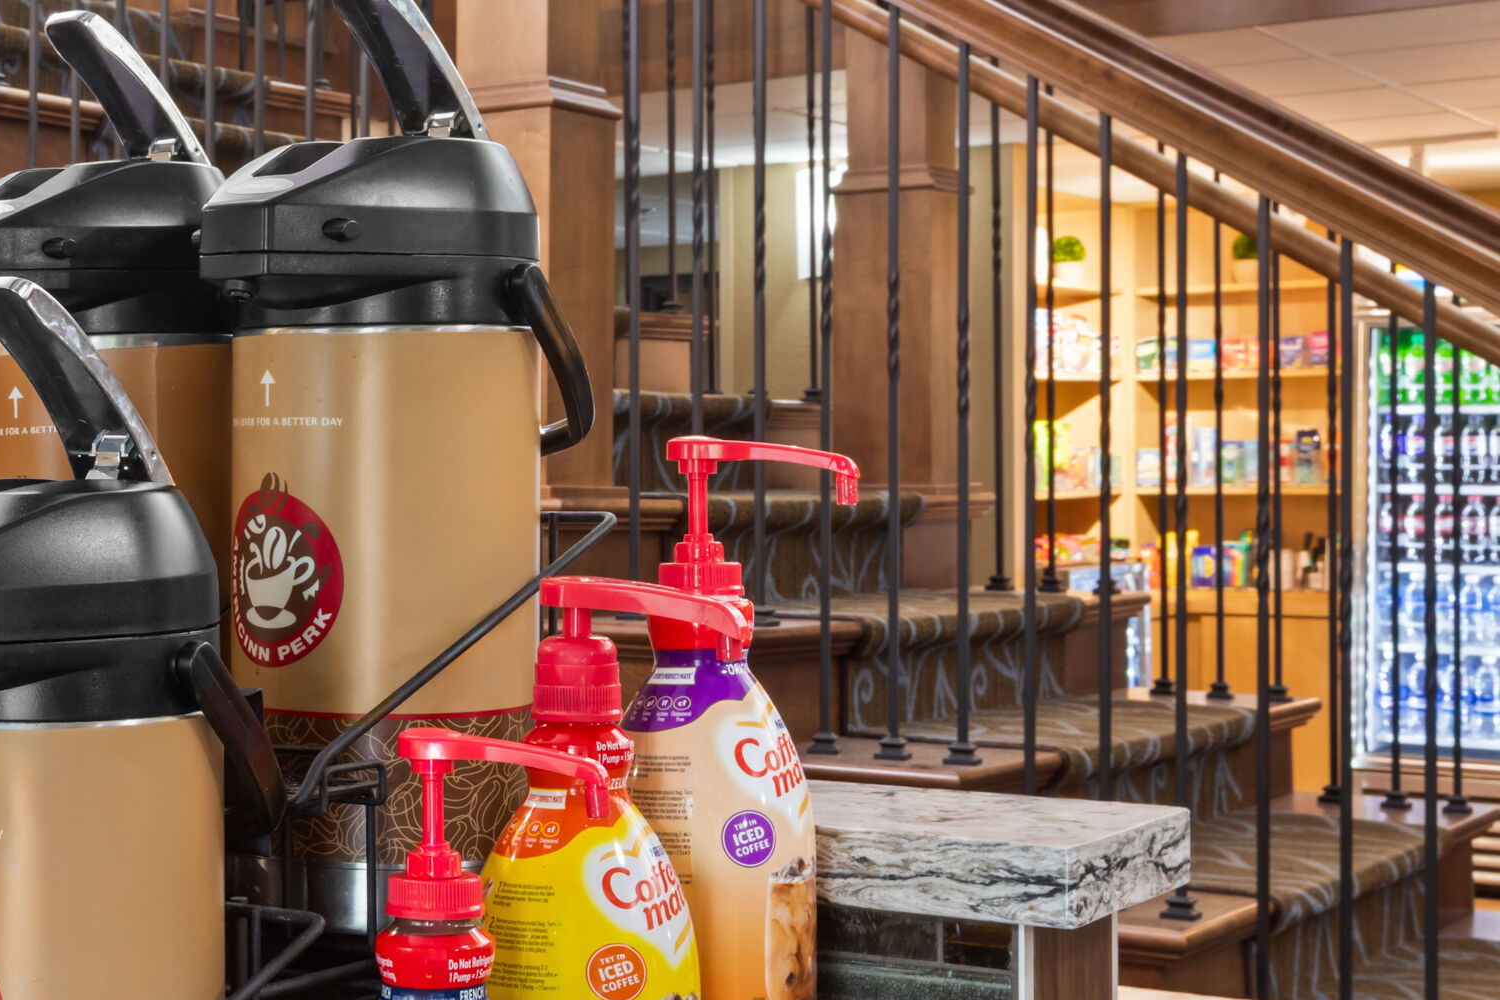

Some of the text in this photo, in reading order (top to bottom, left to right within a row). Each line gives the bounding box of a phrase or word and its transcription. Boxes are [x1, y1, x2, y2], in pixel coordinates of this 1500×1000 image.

[273, 417, 279, 426] A
[281, 417, 317, 426] BETTER
[321, 417, 343, 426] DAY
[277, 608, 332, 661] PERK
[596, 741, 606, 751] Do
[607, 740, 618, 750] Not
[732, 825, 765, 846] ICED
[735, 838, 771, 857] COFFEE
[448, 959, 458, 970] Do
[459, 958, 471, 969] Not
[600, 955, 615, 965] TRY
[453, 972, 471, 984] Pump
[598, 959, 634, 982] ICED
[601, 973, 640, 993] COFFEE
